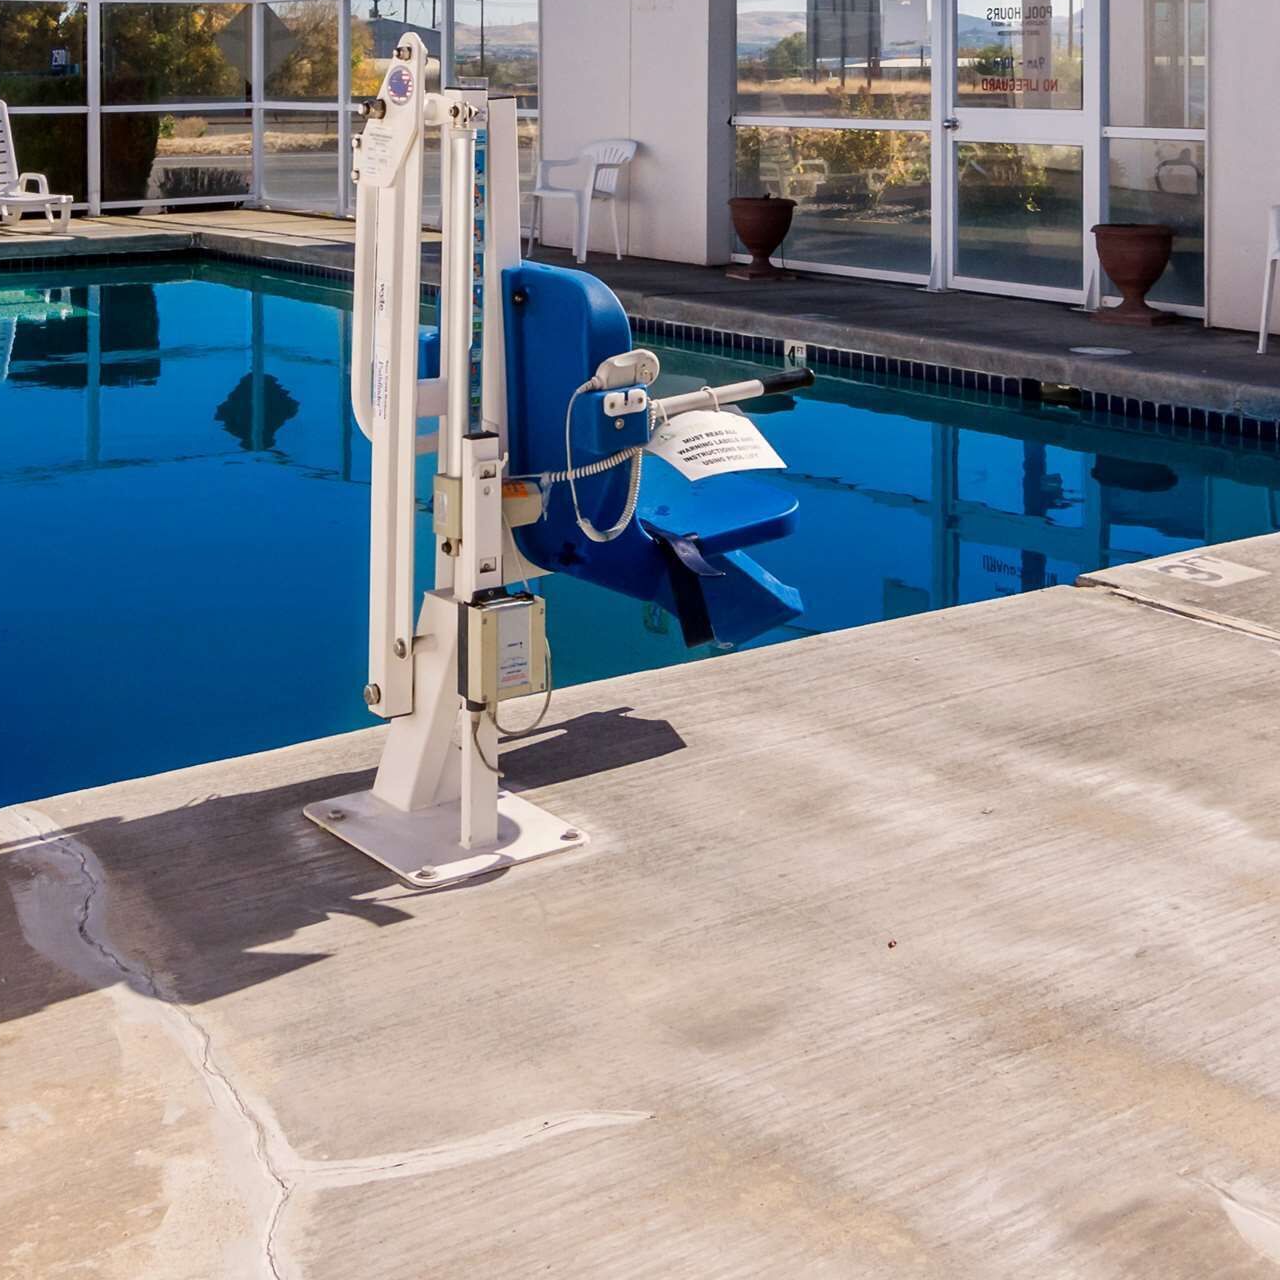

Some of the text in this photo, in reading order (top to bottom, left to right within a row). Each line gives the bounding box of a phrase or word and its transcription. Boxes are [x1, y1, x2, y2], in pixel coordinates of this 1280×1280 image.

[682, 433, 705, 444] MUST
[705, 430, 724, 438] READ
[677, 441, 714, 456] WARNING
[715, 437, 740, 446] LABELS
[683, 446, 737, 463] INSTRUCTIONS
[702, 456, 726, 466] USING
